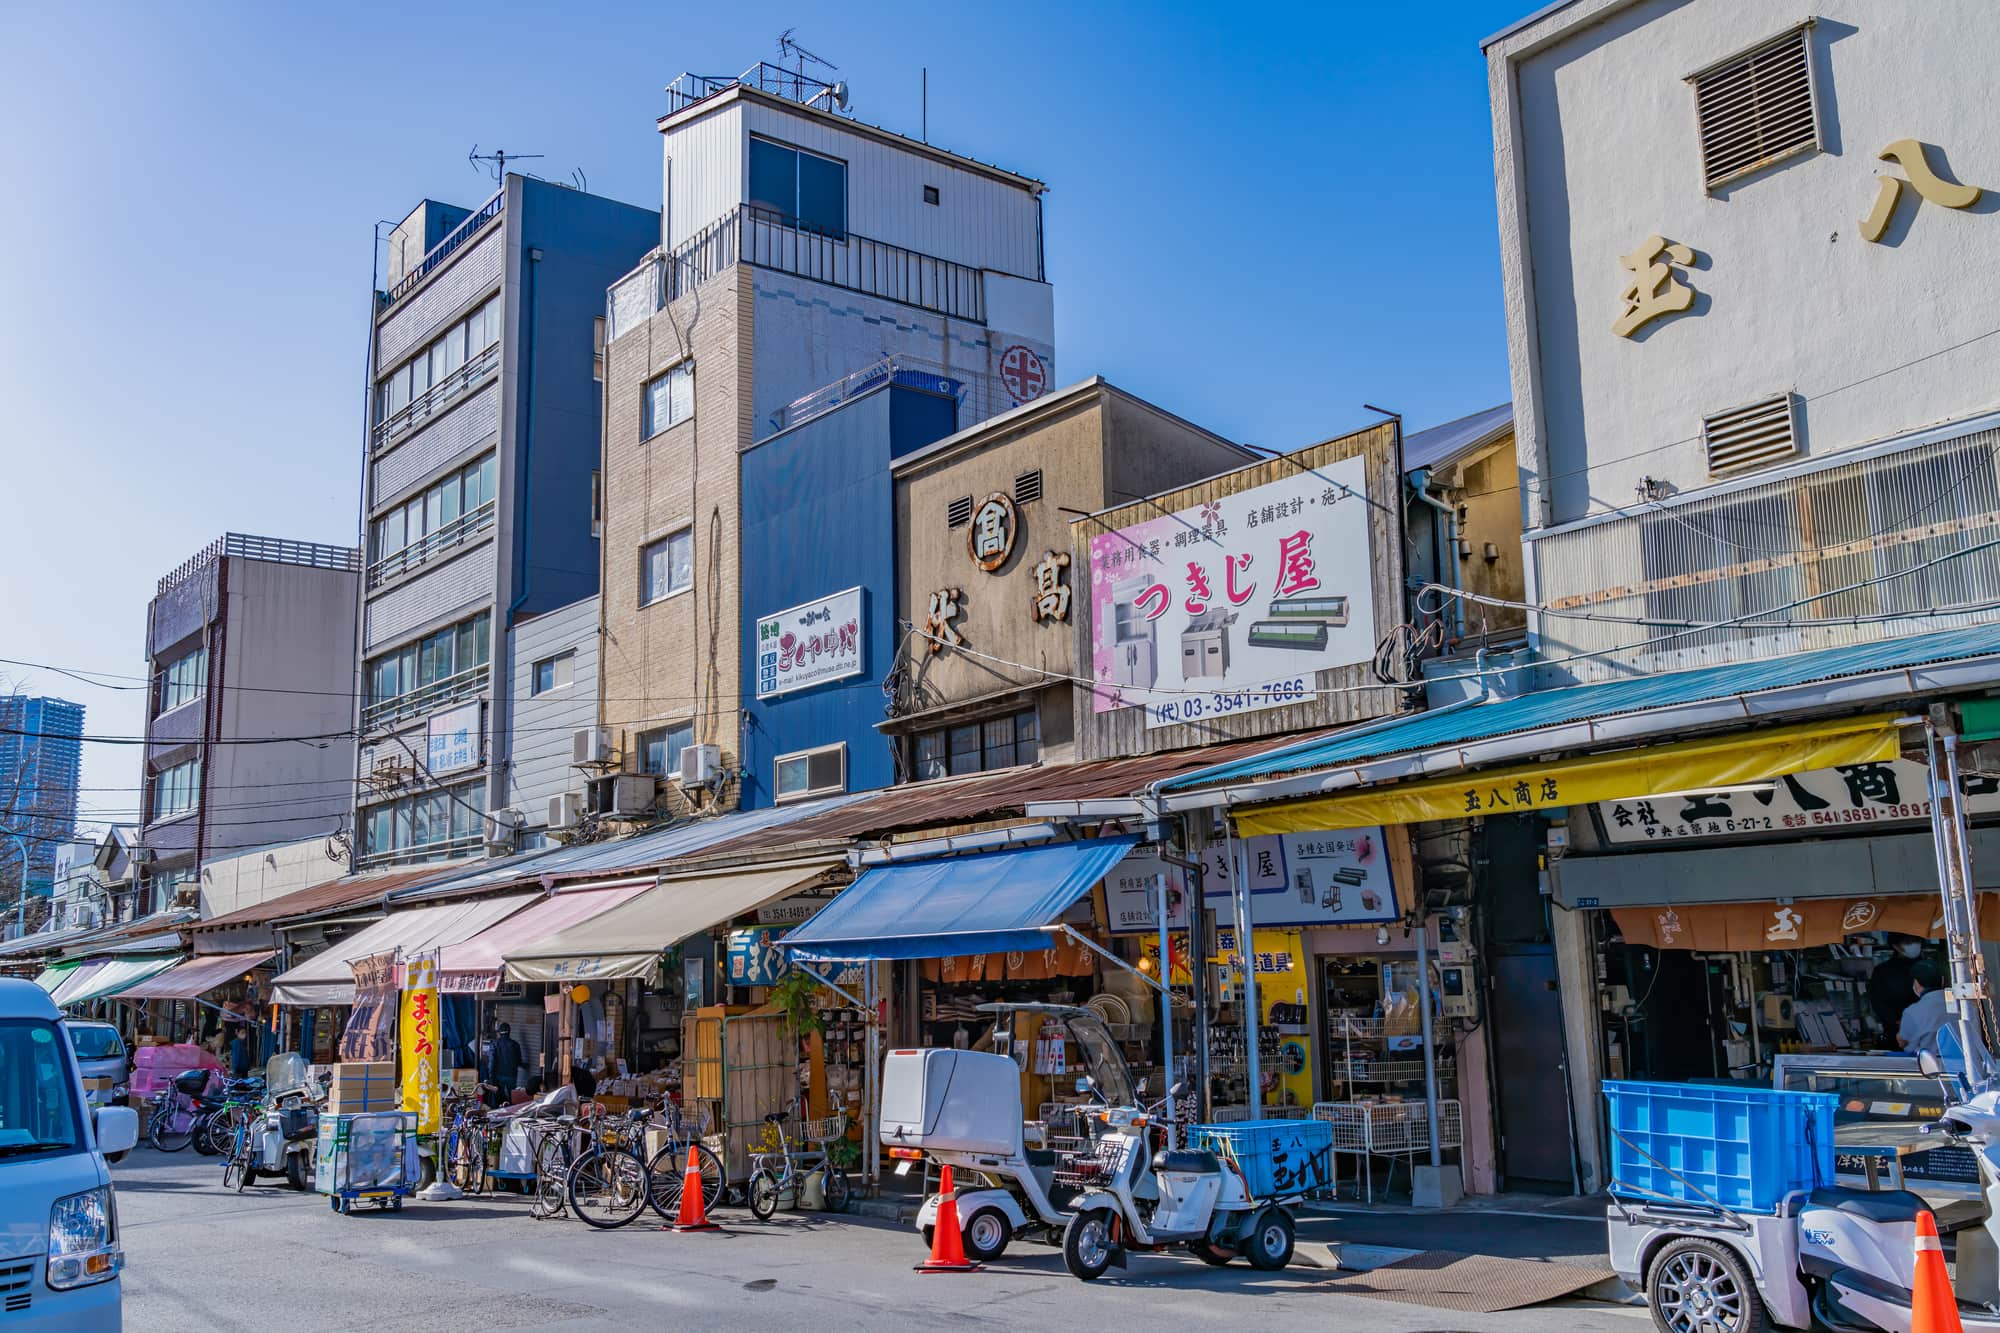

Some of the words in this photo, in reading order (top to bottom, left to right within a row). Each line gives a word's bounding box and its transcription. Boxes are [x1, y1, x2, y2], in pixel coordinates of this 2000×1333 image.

[1246, 484, 1352, 529] 店舗設計・施工
[1134, 530, 1320, 622] つきじ屋
[1184, 679, 1304, 718] 03-3541-7666
[1464, 778, 1558, 812] 玉八商店
[1612, 801, 1660, 827] 会社
[1727, 817, 1772, 832] 6-27-2
[412, 993, 432, 1056] まぐろ
